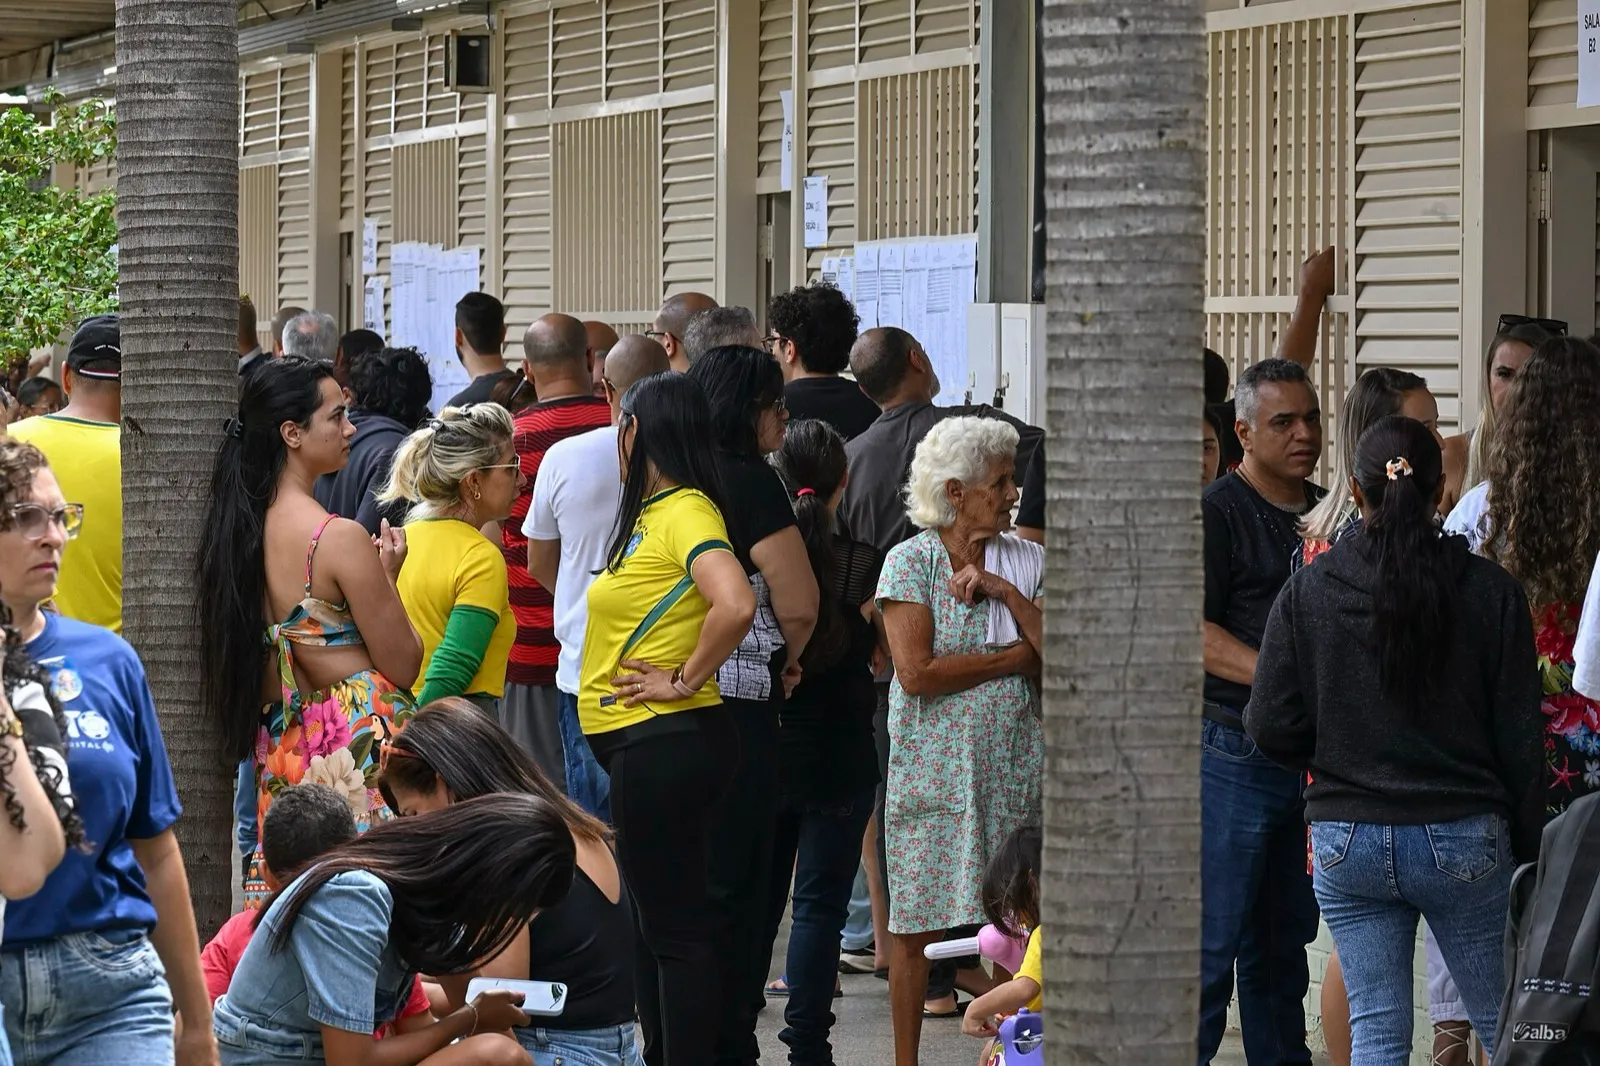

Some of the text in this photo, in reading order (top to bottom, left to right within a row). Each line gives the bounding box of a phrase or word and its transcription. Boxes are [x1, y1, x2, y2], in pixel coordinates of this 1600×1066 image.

[1584, 13, 1600, 30] SALA
[1588, 38, 1596, 53] B2
[1530, 1024, 1566, 1040] alba
